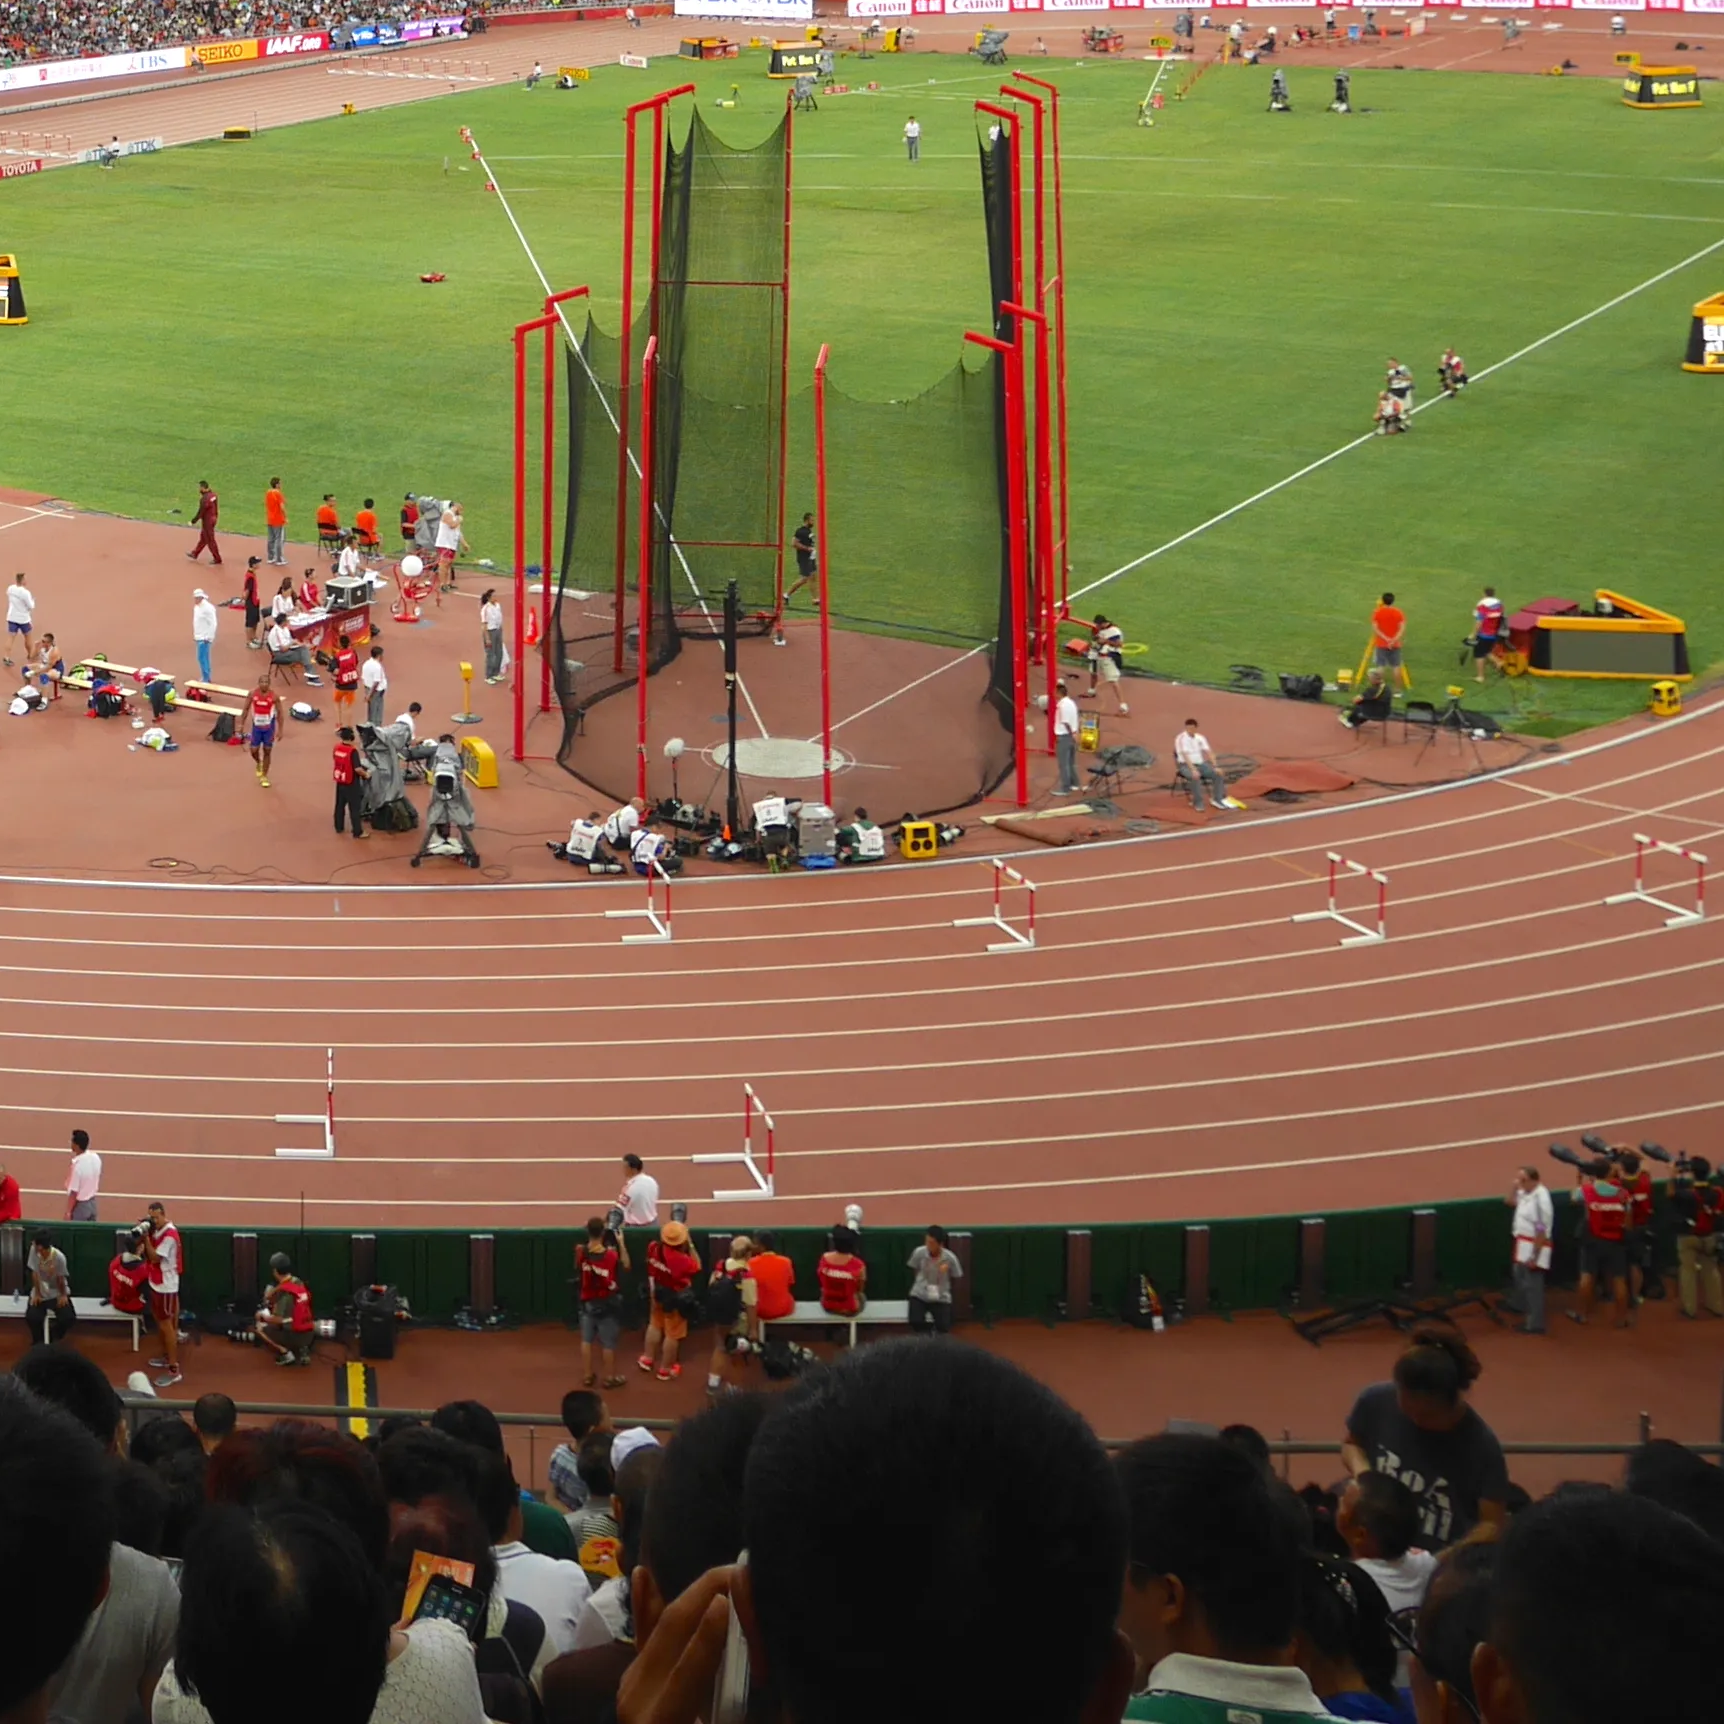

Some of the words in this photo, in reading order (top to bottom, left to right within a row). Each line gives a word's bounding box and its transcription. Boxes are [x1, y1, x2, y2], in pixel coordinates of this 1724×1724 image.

[856, 0, 907, 14] Canon
[198, 44, 243, 61] SEIKO
[266, 35, 322, 55] IAAF.ORG
[1, 160, 37, 177] TOYOTA
